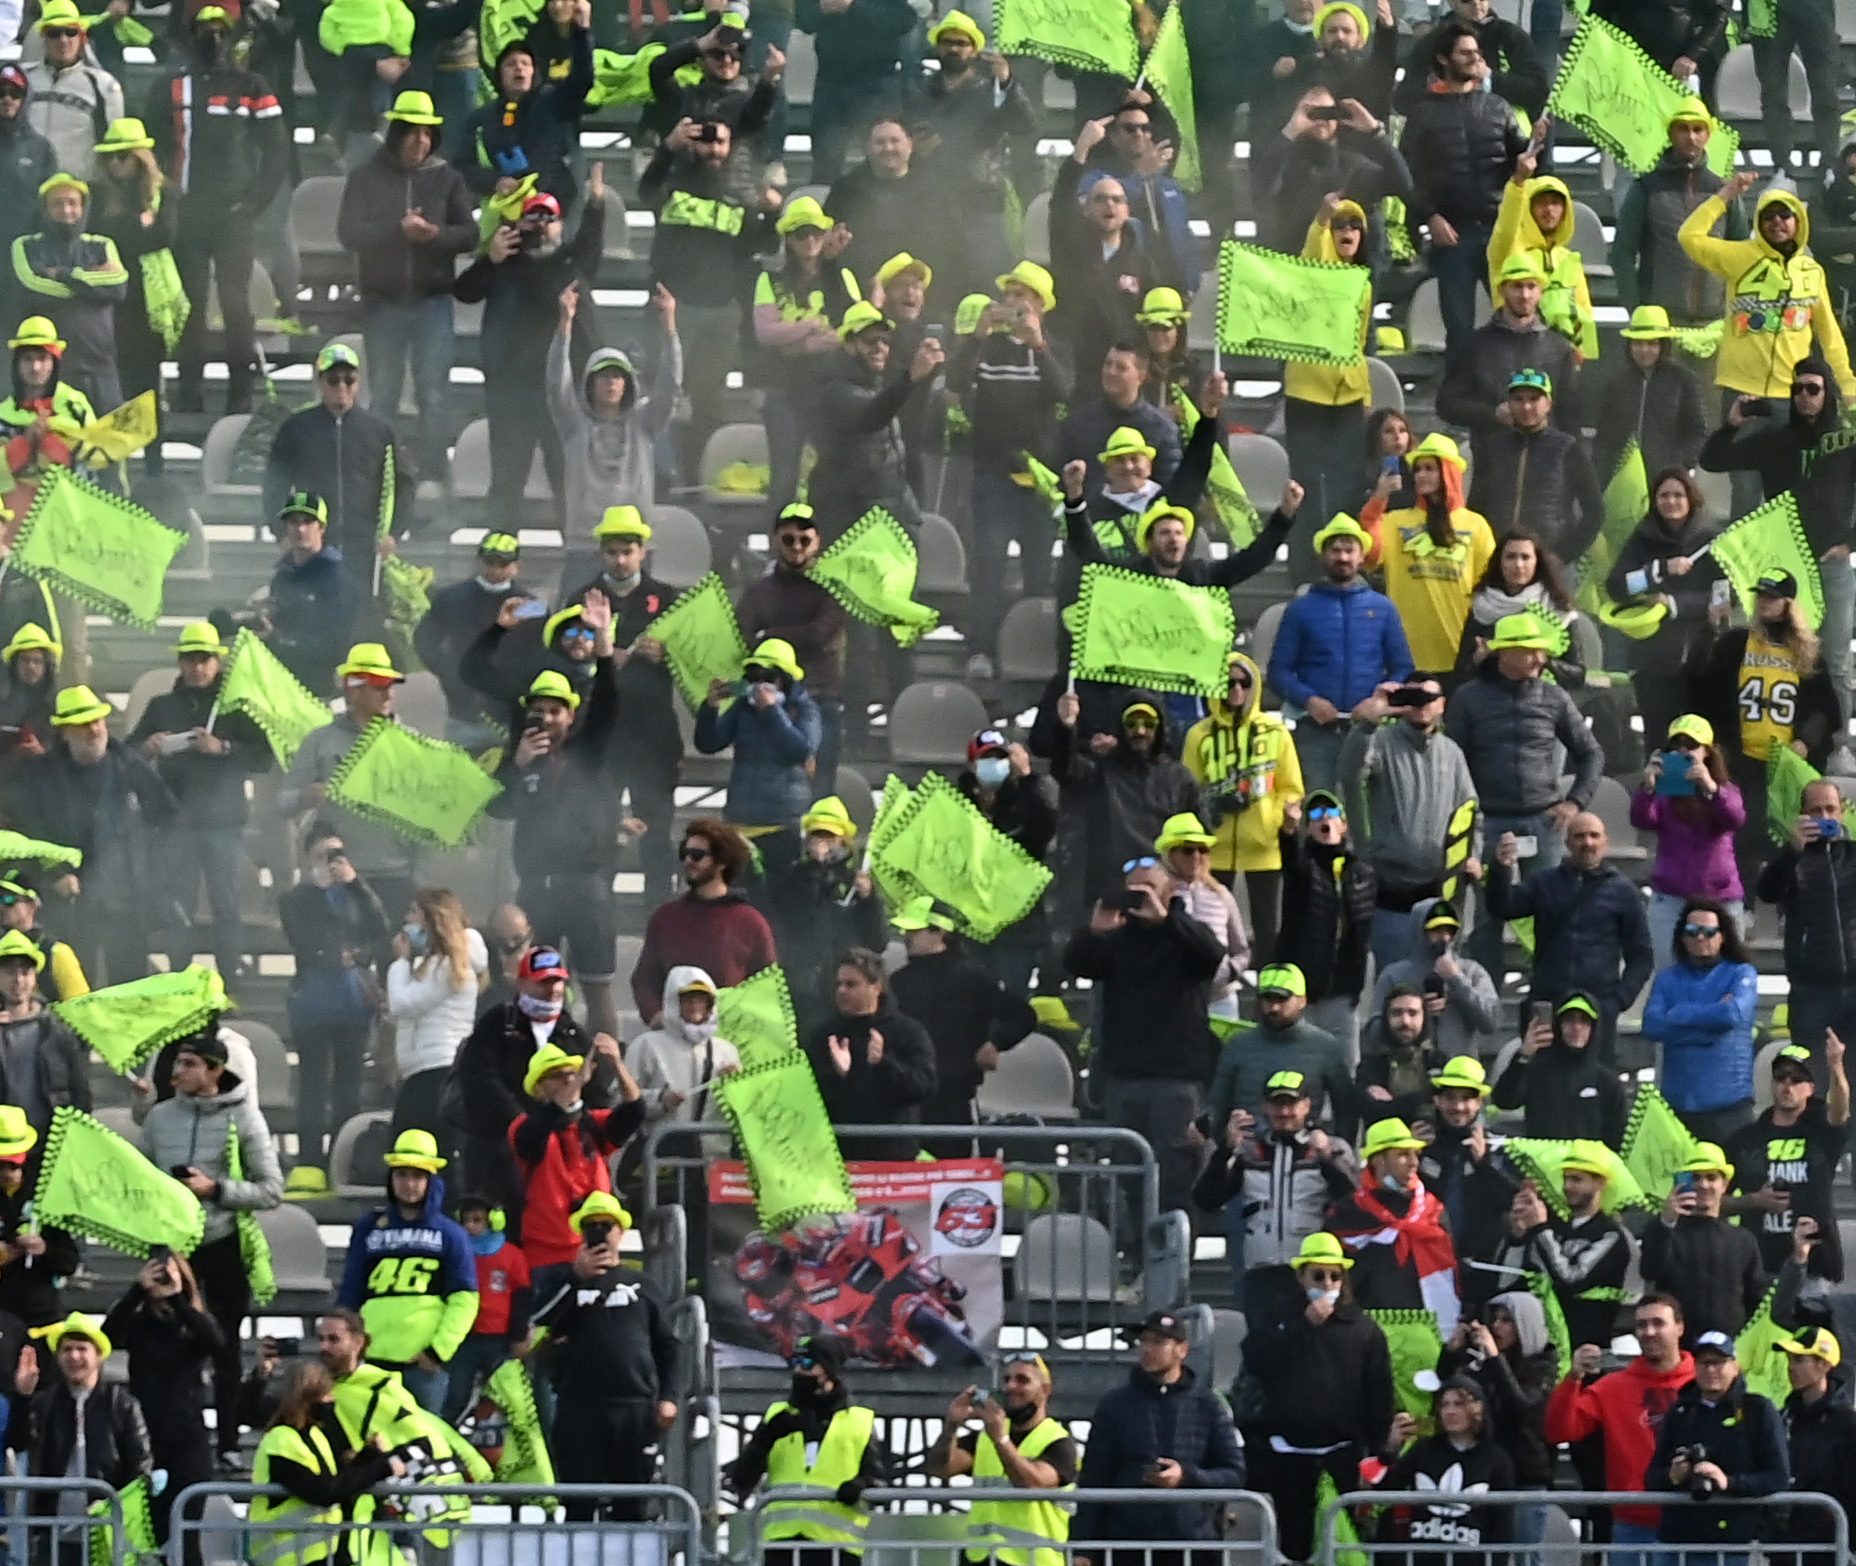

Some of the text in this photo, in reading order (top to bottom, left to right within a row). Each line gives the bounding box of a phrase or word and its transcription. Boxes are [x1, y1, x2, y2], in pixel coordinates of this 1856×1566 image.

[1743, 650, 1793, 671] ROSS
[1738, 678, 1798, 725] 46
[1768, 1161, 1809, 1183] HANK
[1763, 1209, 1793, 1234] ALE
[367, 1257, 440, 1294] 46
[1409, 1517, 1481, 1546] adidas
